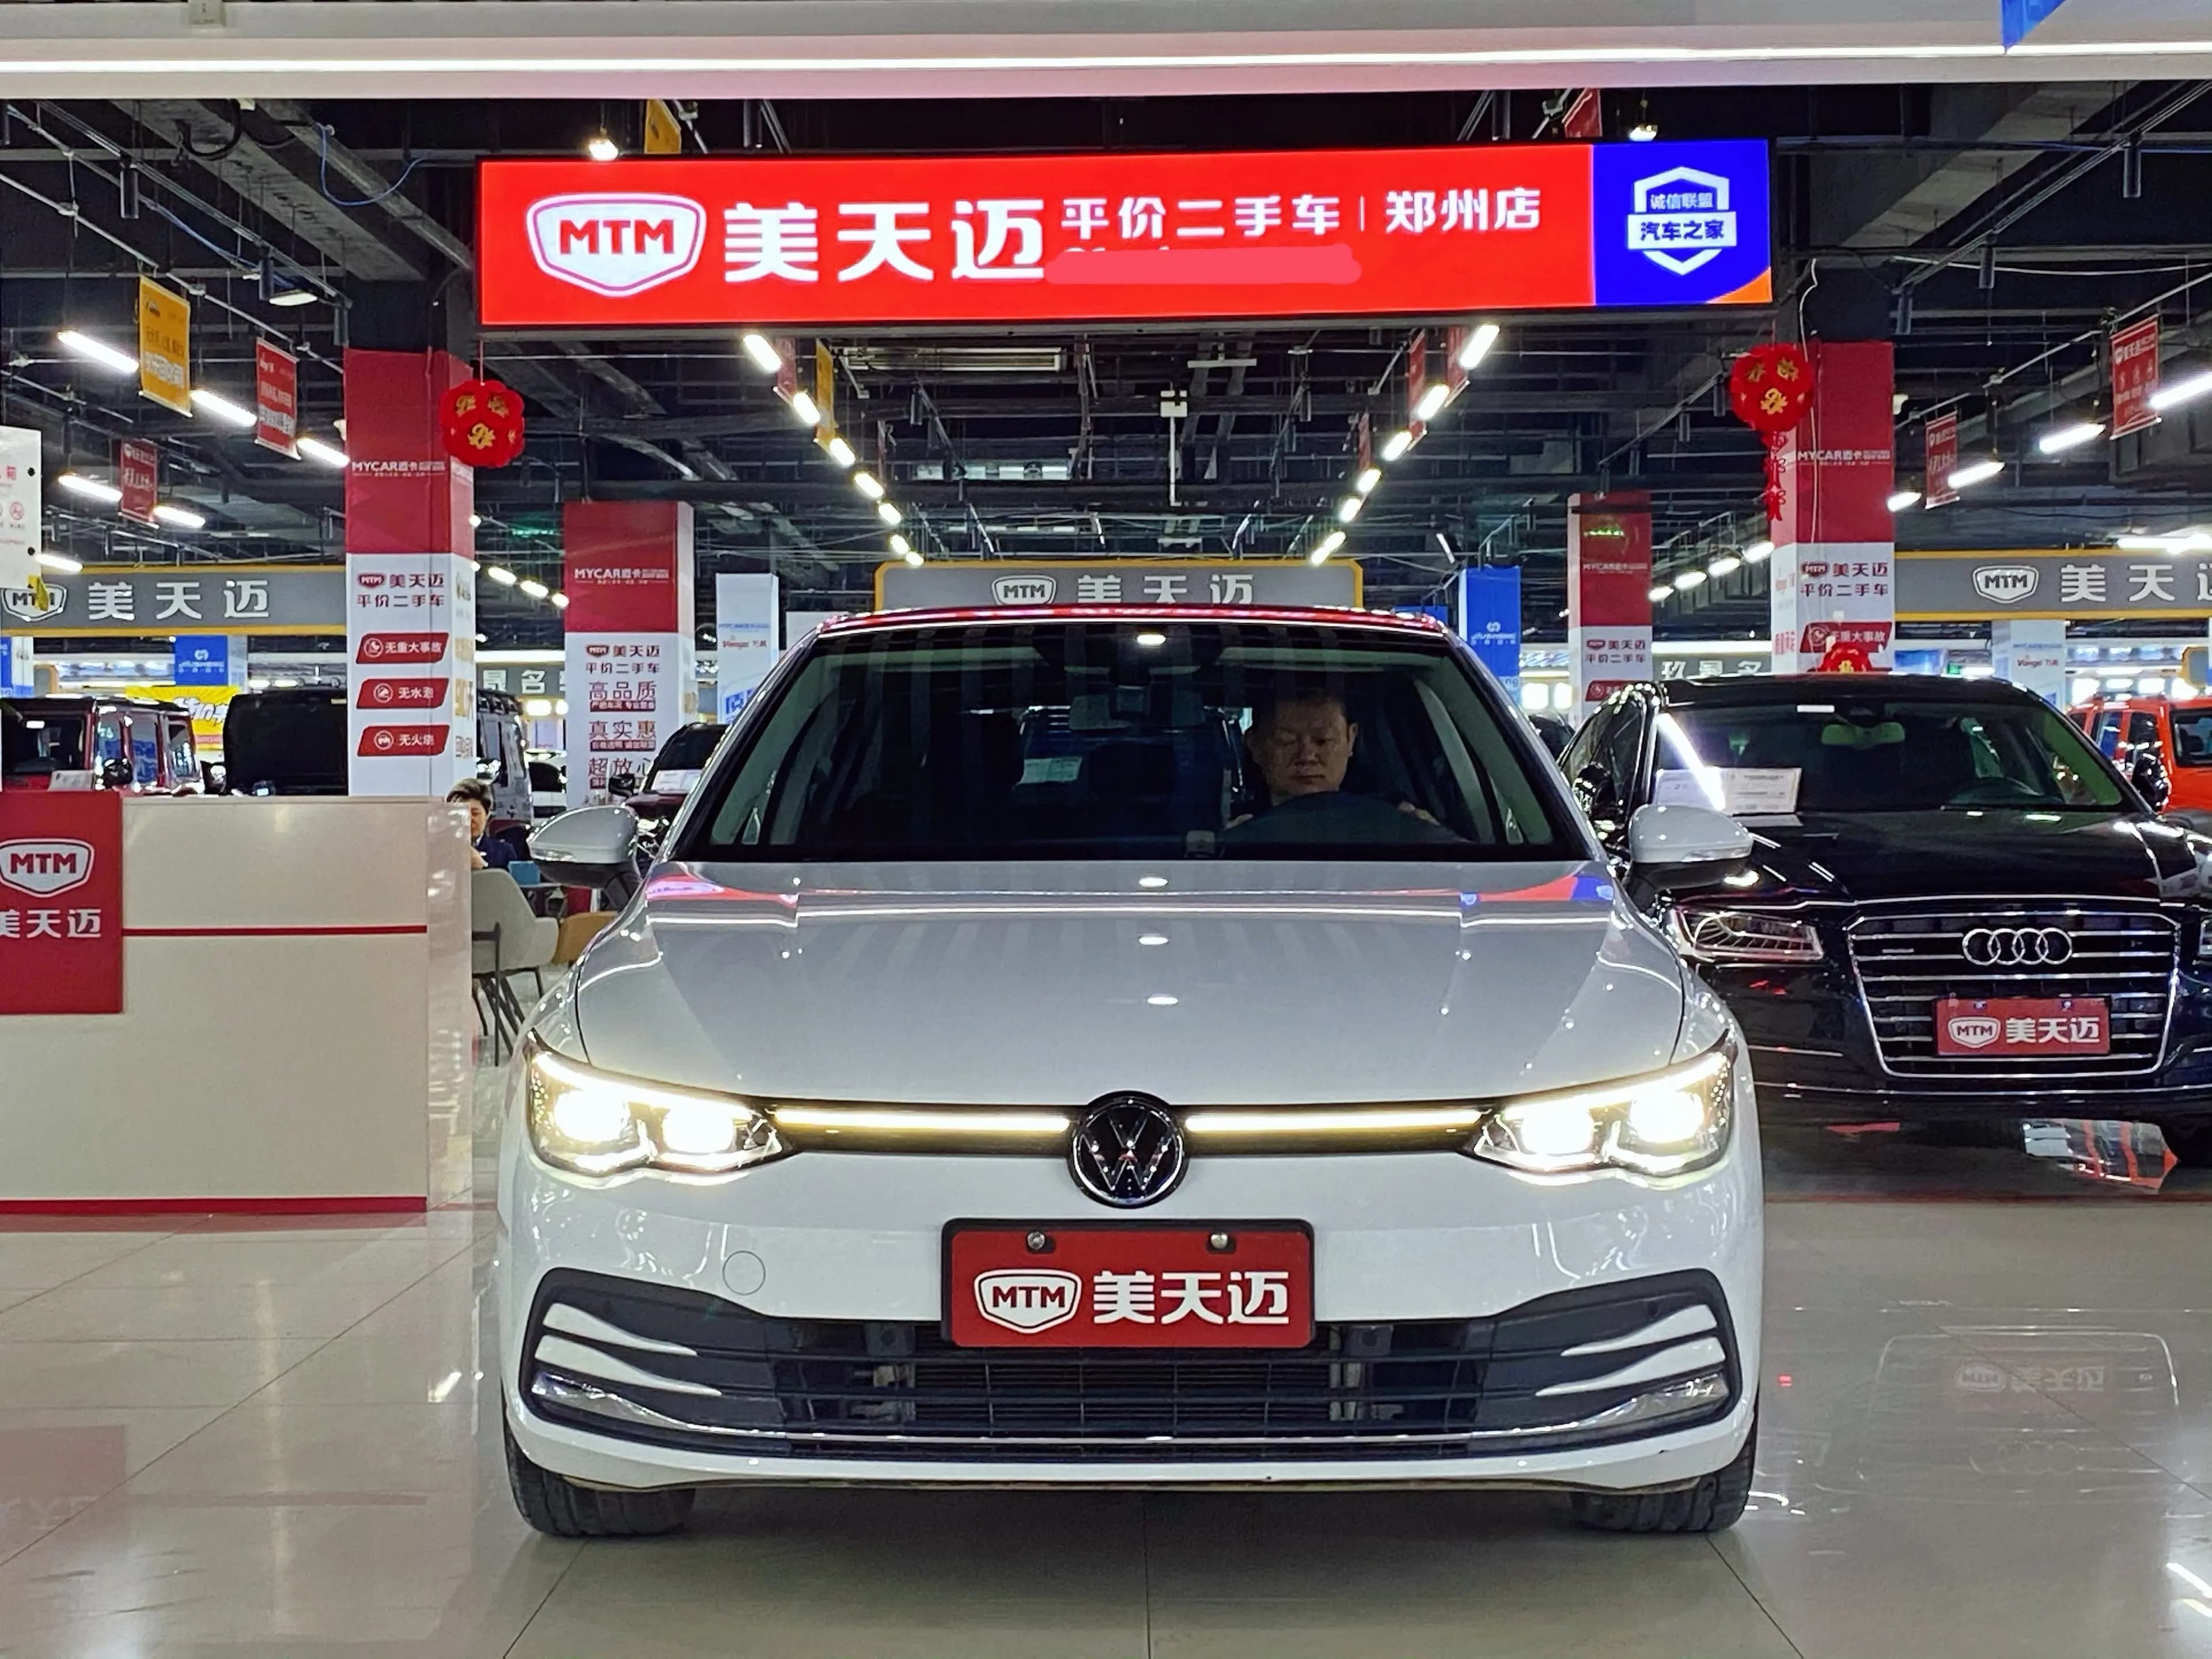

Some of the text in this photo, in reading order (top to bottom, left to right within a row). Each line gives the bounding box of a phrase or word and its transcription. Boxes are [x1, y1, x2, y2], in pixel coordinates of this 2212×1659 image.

[1650, 192, 1713, 209] 诚信联盟
[1061, 187, 1541, 241] 平价二手车 郑州店
[1641, 221, 1724, 241] 汽车之家
[560, 219, 676, 254] MTM
[725, 199, 1044, 283] 美天迈
[1833, 562, 1888, 577] 美天迈
[389, 574, 444, 588] 美天迈
[1801, 584, 1888, 597] 平价二手车
[1984, 564, 2212, 602] MTM 美天
[88, 582, 268, 619] 美天迈
[357, 594, 444, 607] 平价二手车
[1003, 585, 1045, 597] MTM
[385, 642, 442, 653] 无重大事故
[613, 645, 660, 657] 美天迈
[586, 662, 660, 673] 平价二手车
[589, 681, 656, 701] 高品质
[589, 721, 656, 740] 真实惠
[10, 853, 77, 873] MTM
[1957, 1017, 2100, 1044] MTM 美天迈
[992, 1271, 1289, 1324] MTM 美天迈
